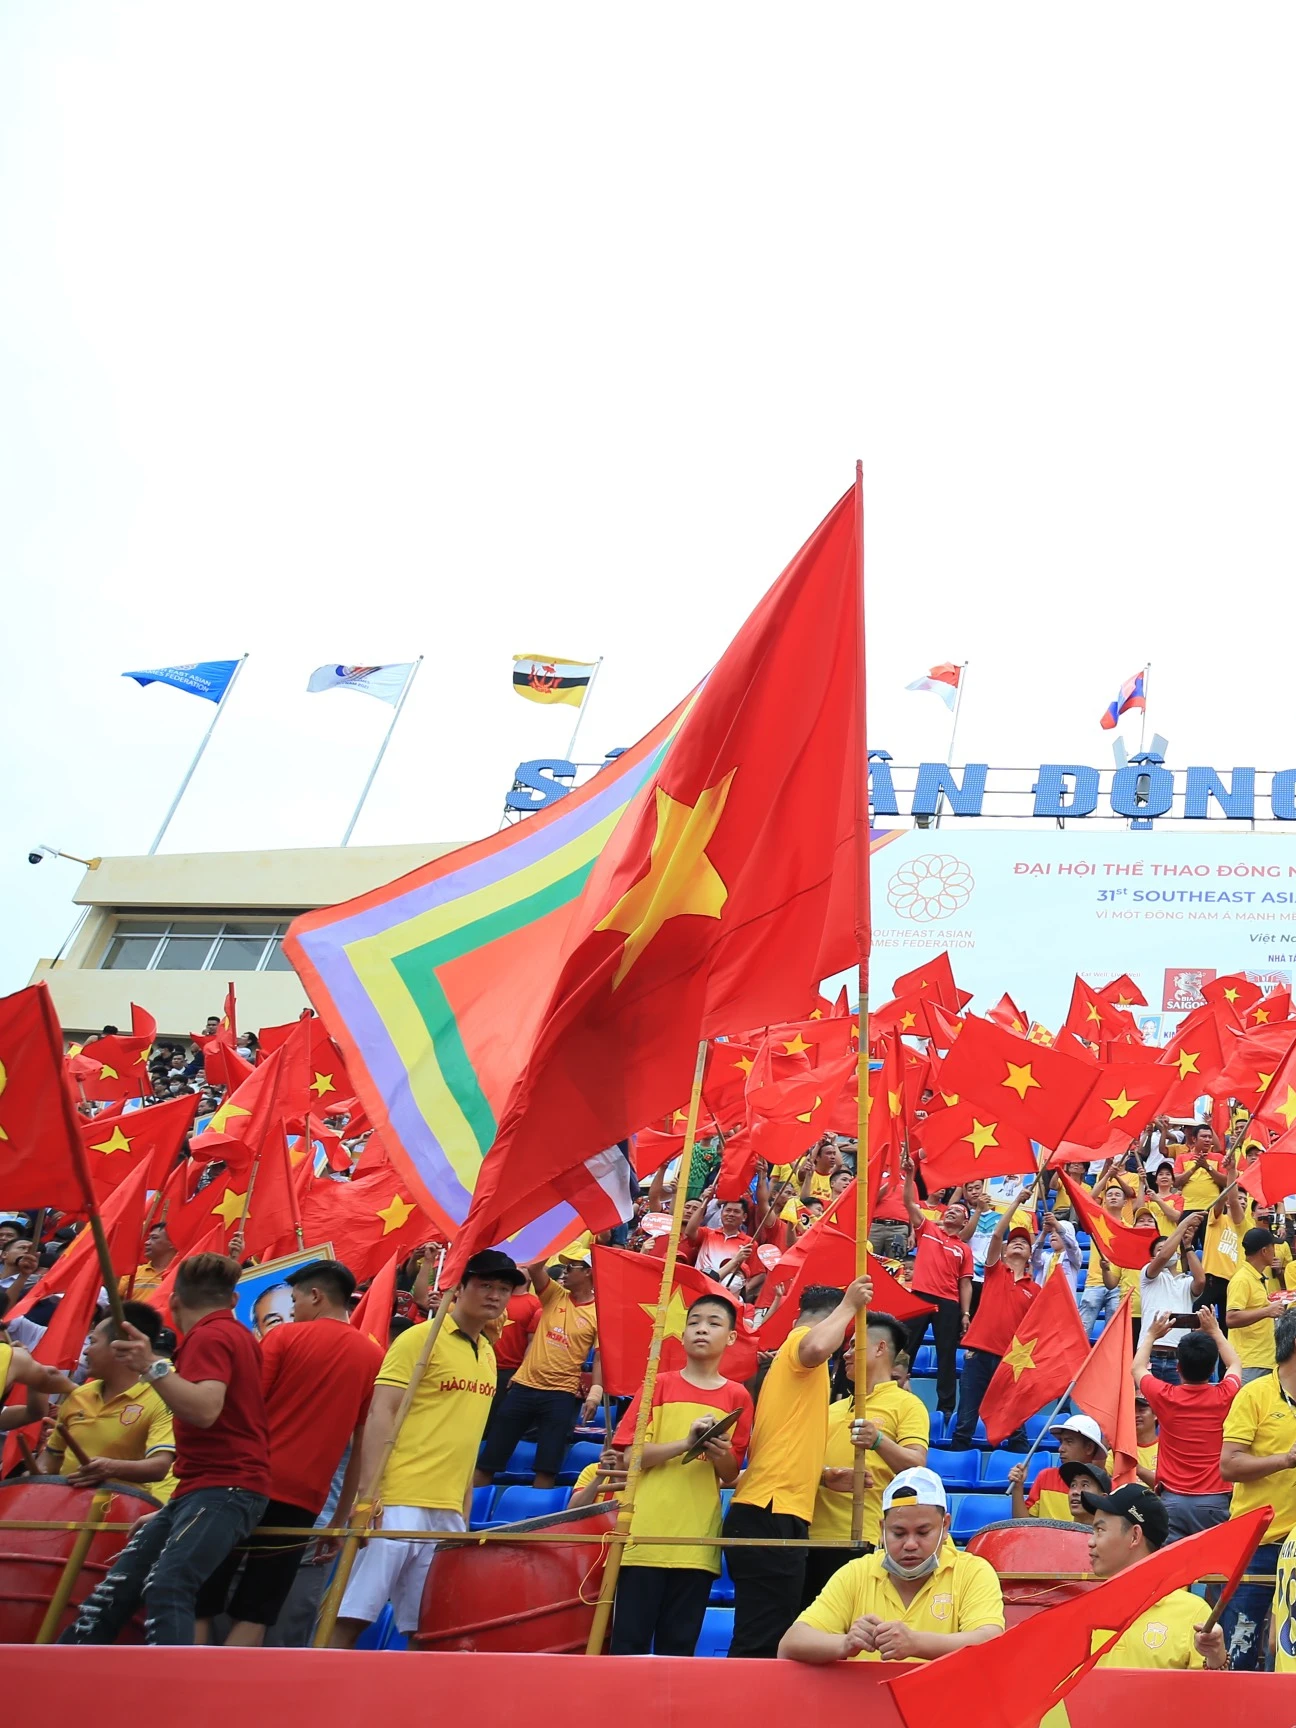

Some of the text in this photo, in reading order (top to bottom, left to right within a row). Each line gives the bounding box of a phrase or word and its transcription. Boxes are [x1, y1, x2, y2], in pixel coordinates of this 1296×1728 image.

[1012, 862, 1051, 878] ĐẠI
[1057, 860, 1096, 879] HỘI
[1102, 859, 1144, 876] THỂ
[1150, 864, 1210, 877] THAO
[1216, 862, 1281, 878] ĐÔNG
[1132, 889, 1256, 903] SOUTHEAST
[1188, 911, 1219, 920] NAM
[872, 929, 973, 938] OUTHEAST ASIAN
[1249, 932, 1276, 945] Việt
[872, 939, 976, 949] AMES FEDERATION
